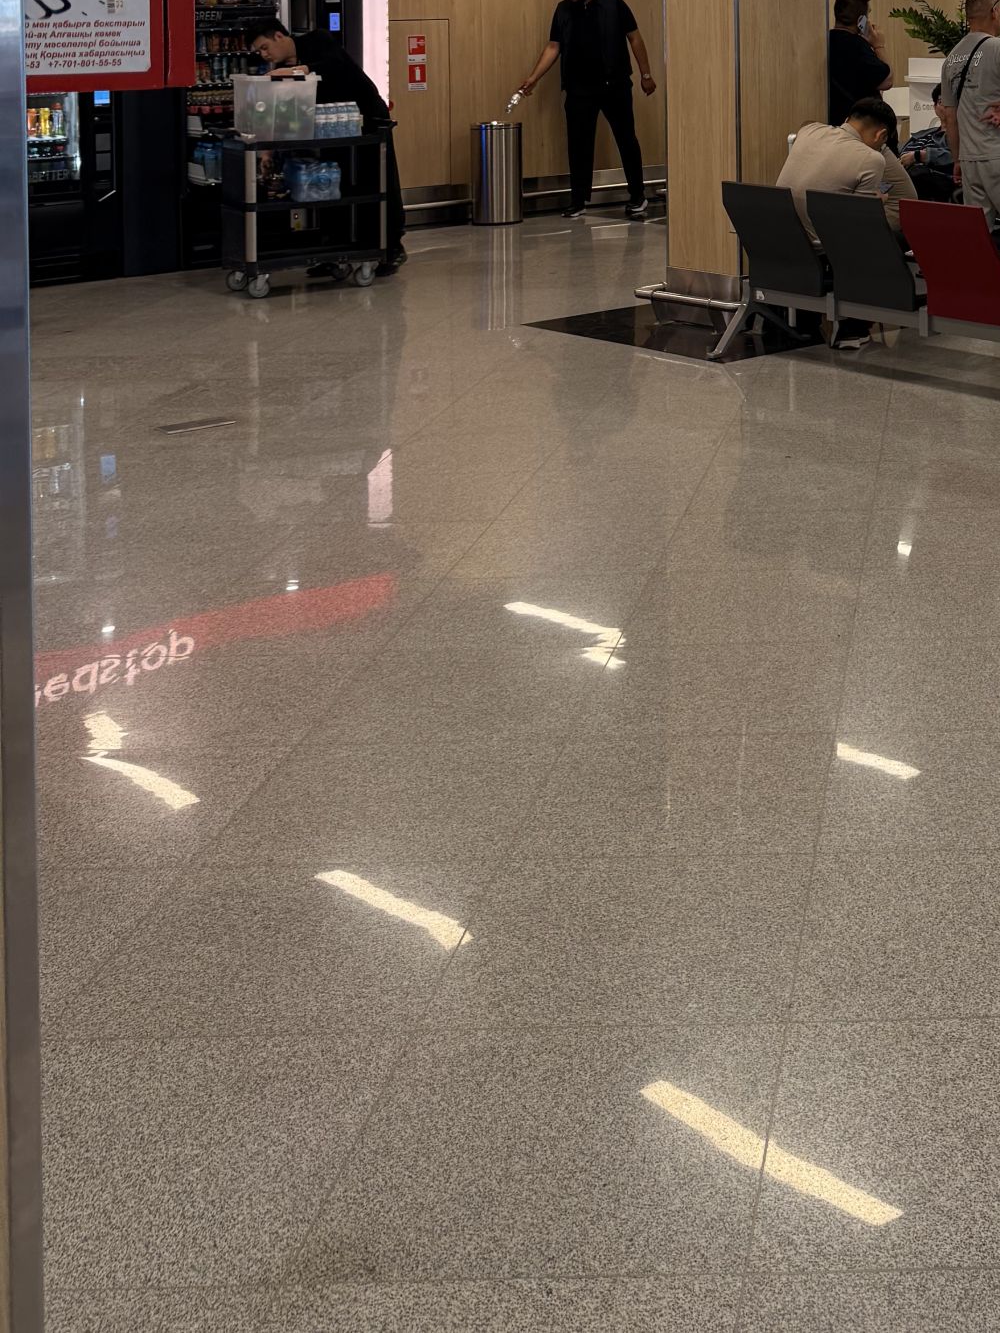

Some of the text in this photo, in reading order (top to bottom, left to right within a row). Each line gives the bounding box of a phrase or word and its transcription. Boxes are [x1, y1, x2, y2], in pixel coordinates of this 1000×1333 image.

[93, 19, 145, 30] бокстарын
[98, 40, 141, 48] бойынша
[40, 51, 76, 61] Қорына
